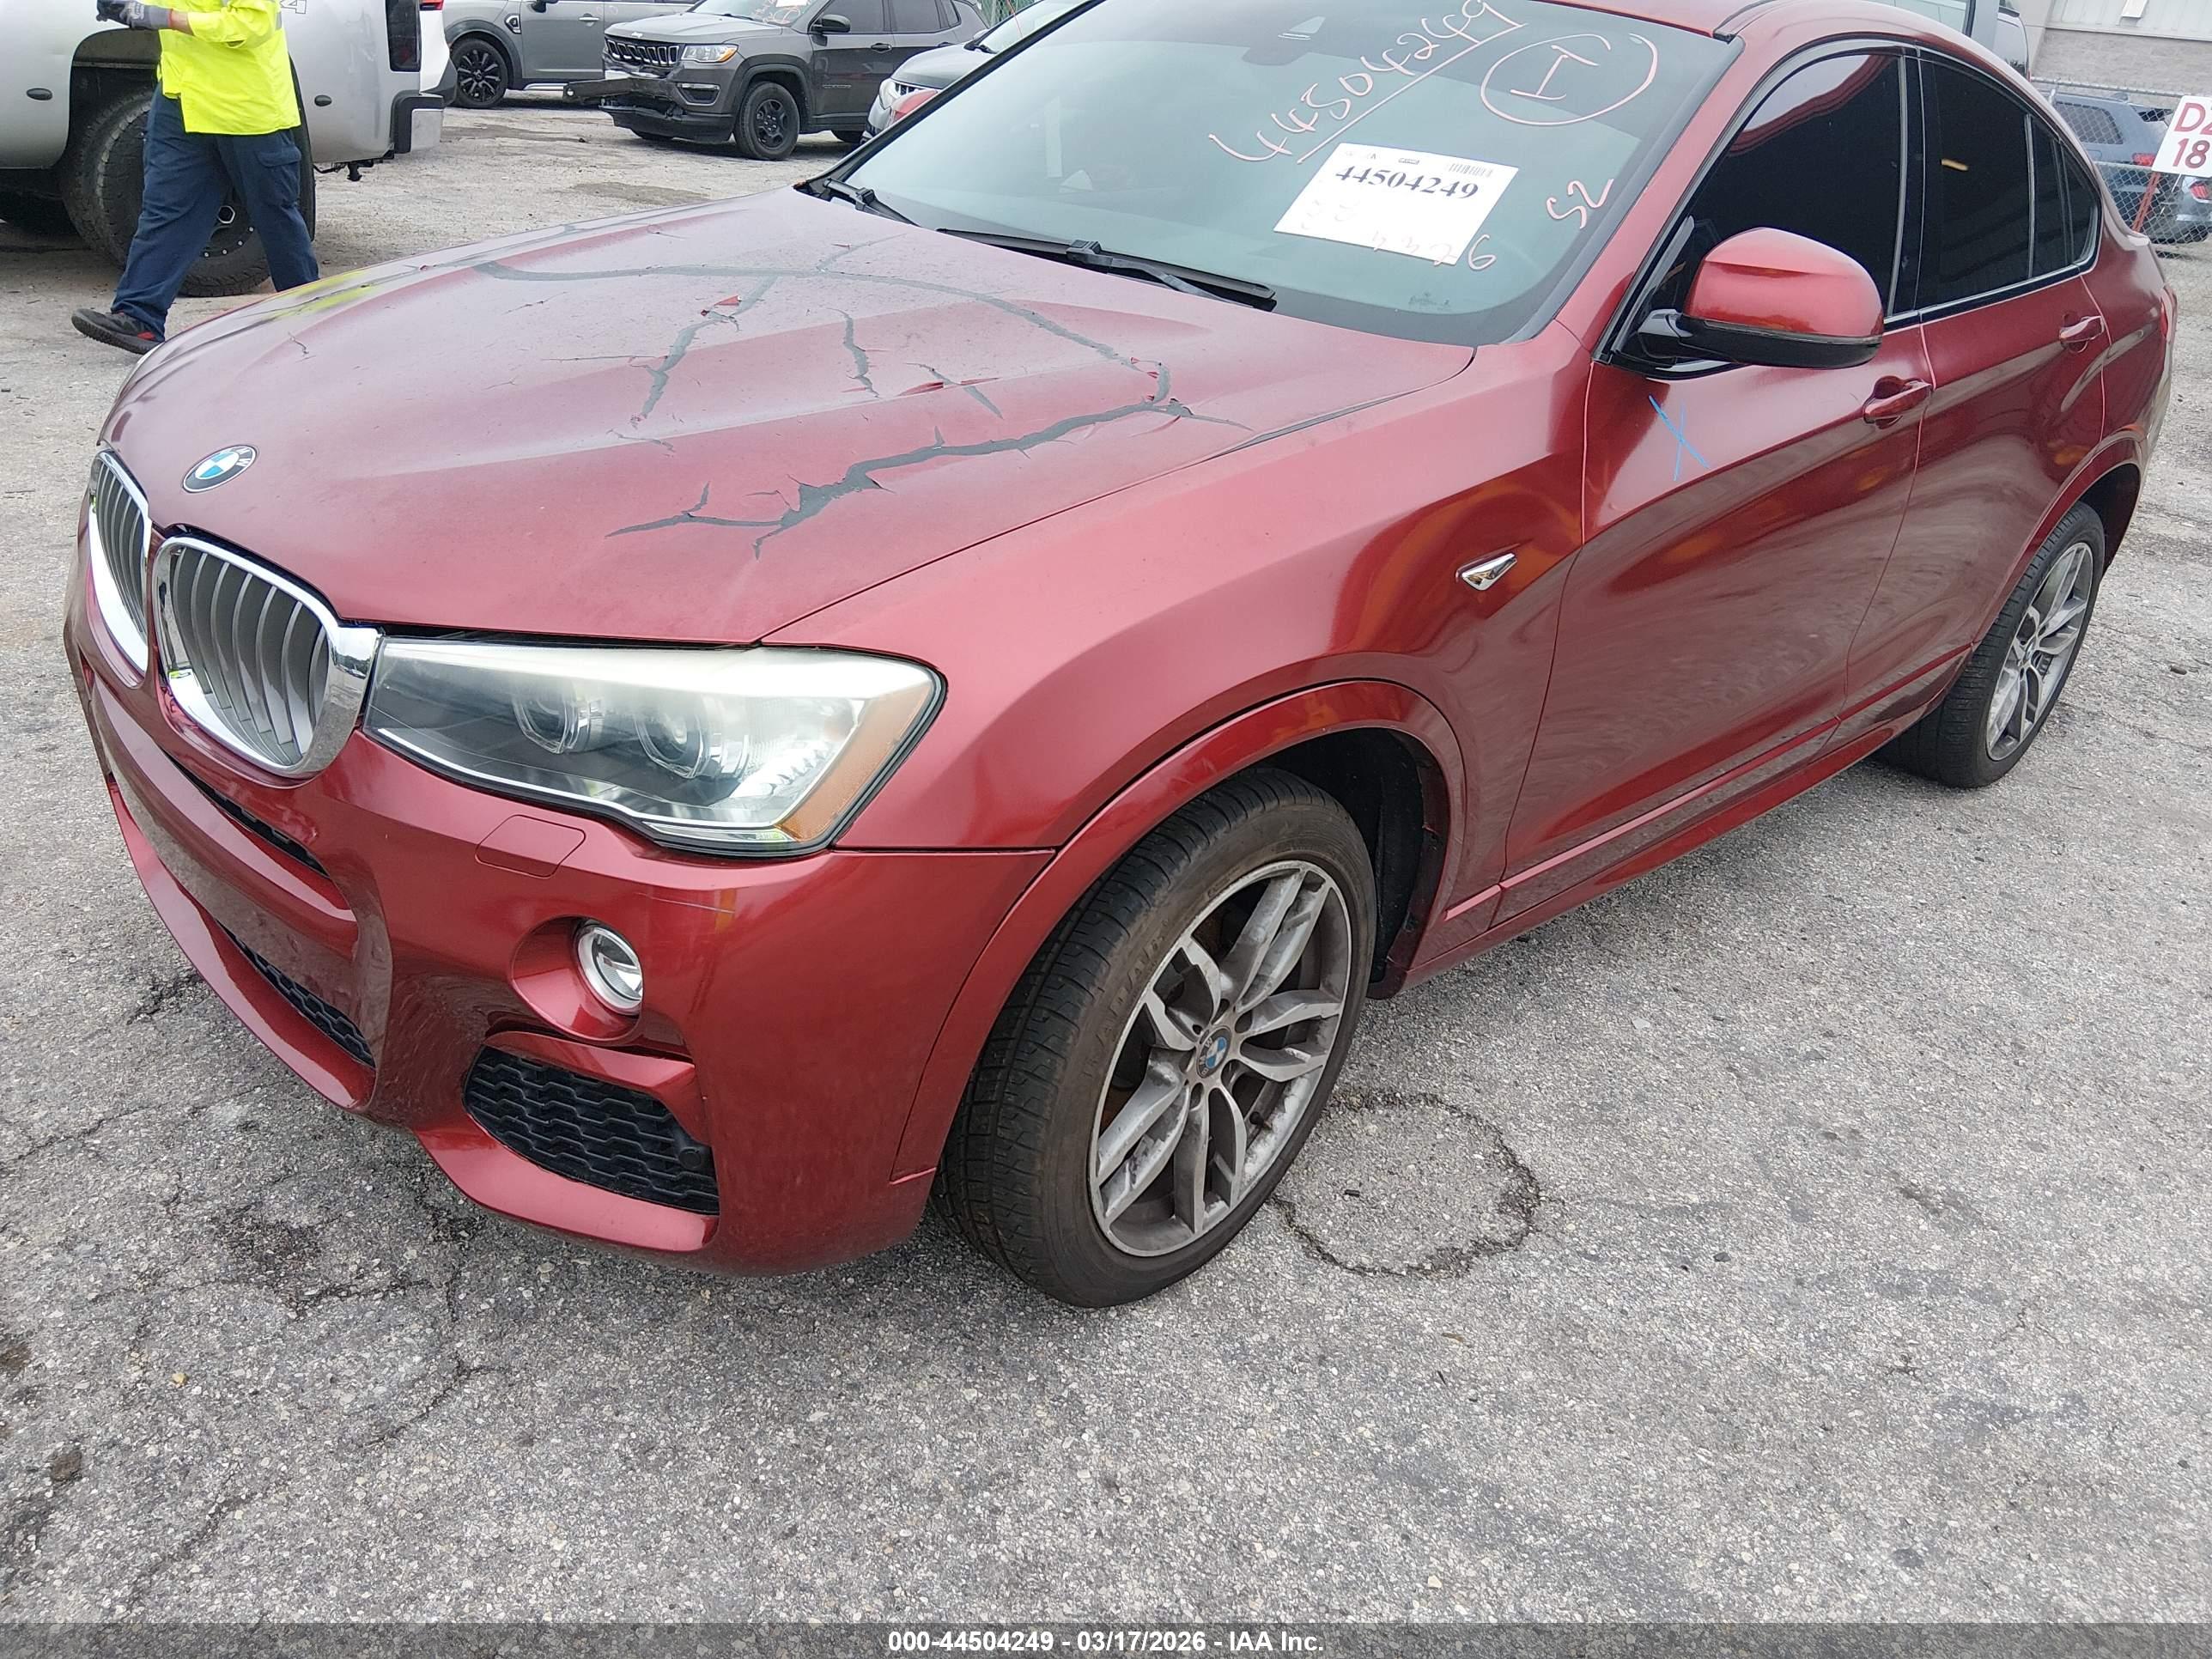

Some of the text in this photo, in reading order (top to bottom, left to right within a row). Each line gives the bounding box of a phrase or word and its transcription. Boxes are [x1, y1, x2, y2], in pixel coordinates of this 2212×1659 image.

[1208, 0, 1525, 161] 44504249
[2172, 138, 2210, 169] 18
[1335, 166, 1479, 198] 44504249
